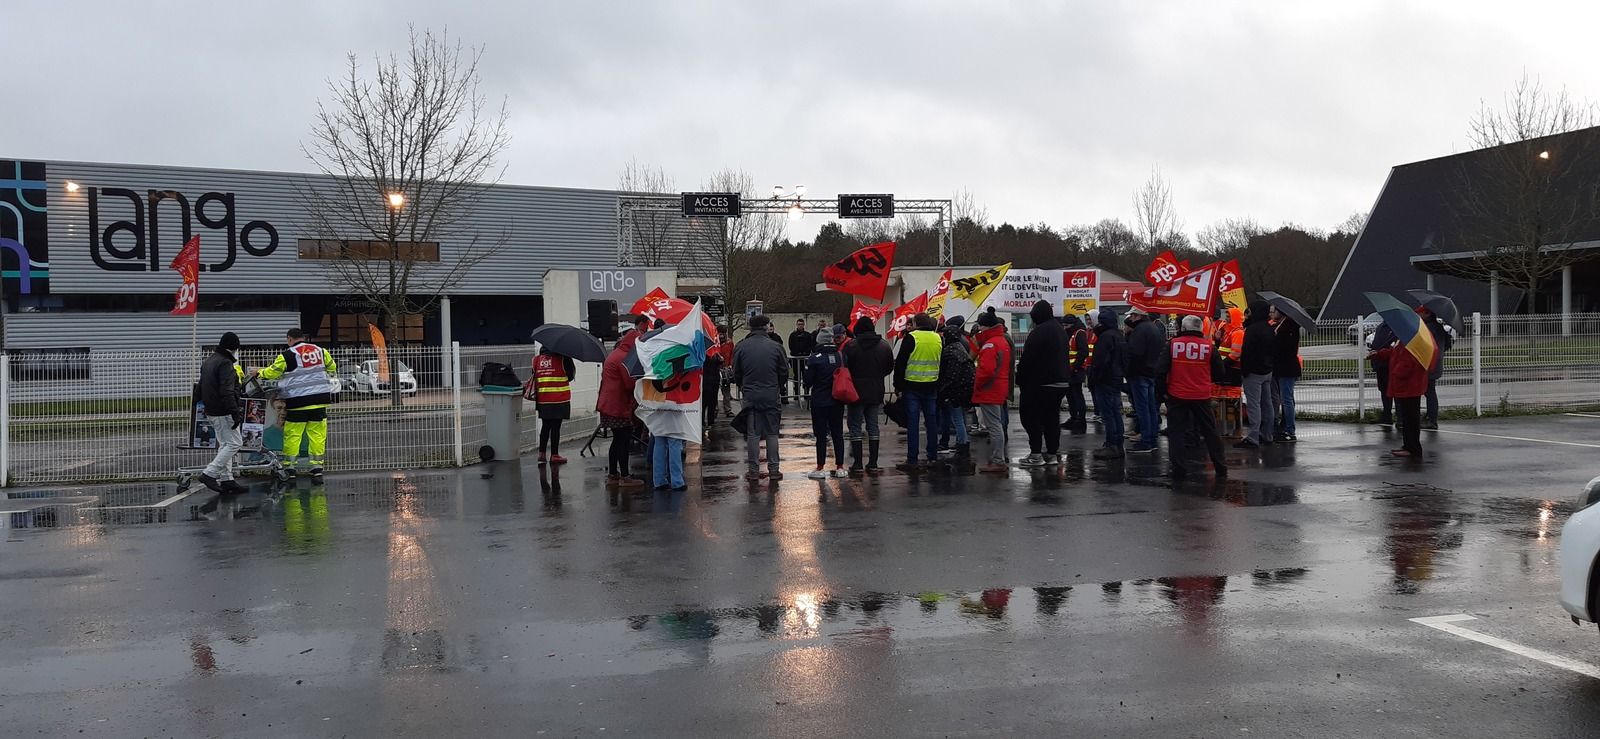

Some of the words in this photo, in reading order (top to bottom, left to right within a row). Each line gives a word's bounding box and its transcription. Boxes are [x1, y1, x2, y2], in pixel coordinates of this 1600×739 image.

[694, 197, 729, 207] ACCES
[850, 198, 883, 208] ACCES
[1071, 276, 1088, 287] cgt
[1172, 341, 1210, 360] PCF
[301, 350, 322, 365] cgt
